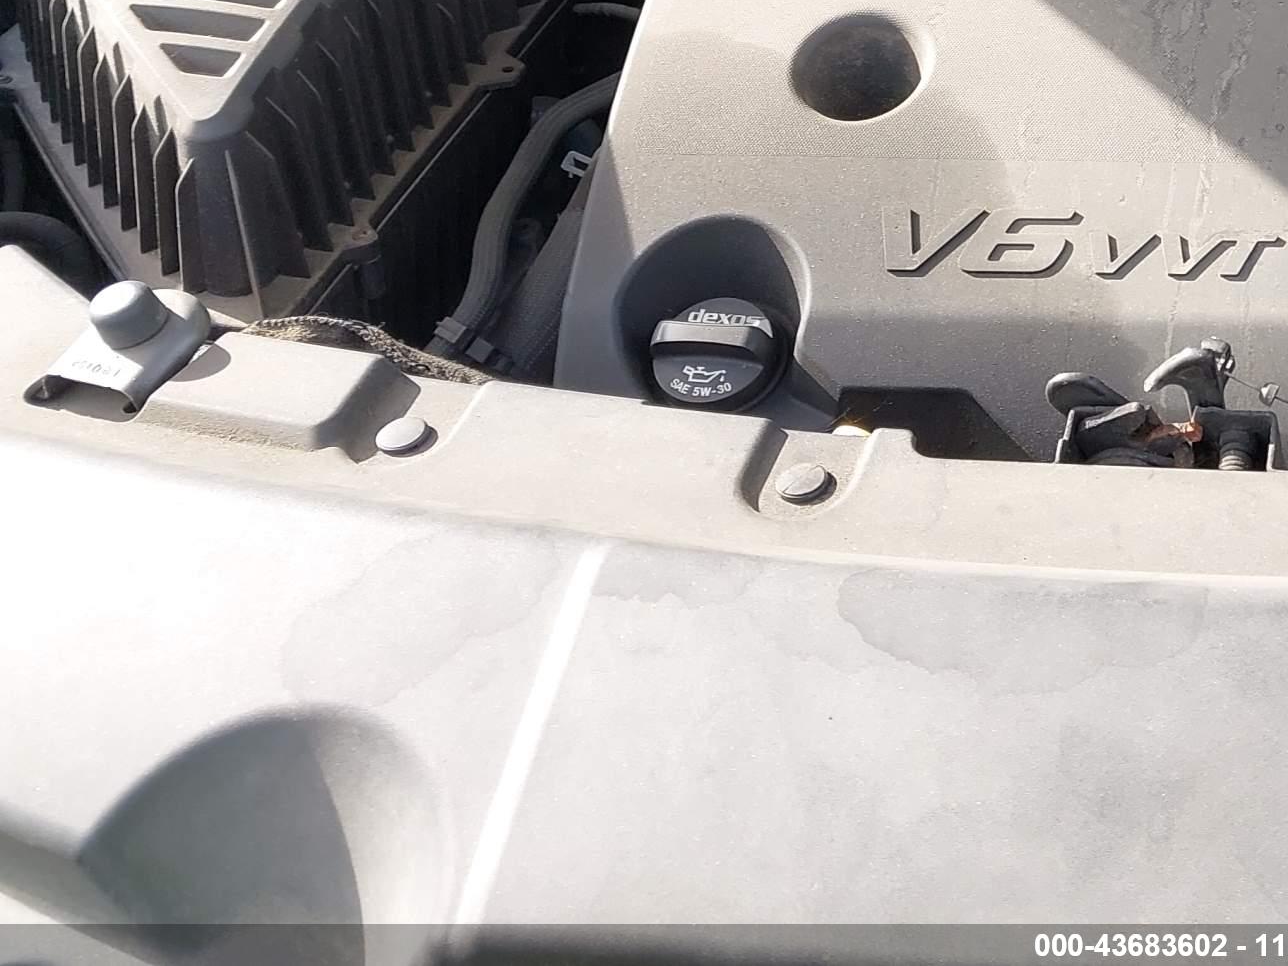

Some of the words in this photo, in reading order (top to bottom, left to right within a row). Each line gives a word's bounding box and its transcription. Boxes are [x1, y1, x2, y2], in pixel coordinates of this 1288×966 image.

[881, 207, 1085, 279] V6
[687, 308, 762, 327] dexos
[670, 378, 692, 395] SAE
[691, 381, 732, 397] 5W-30
